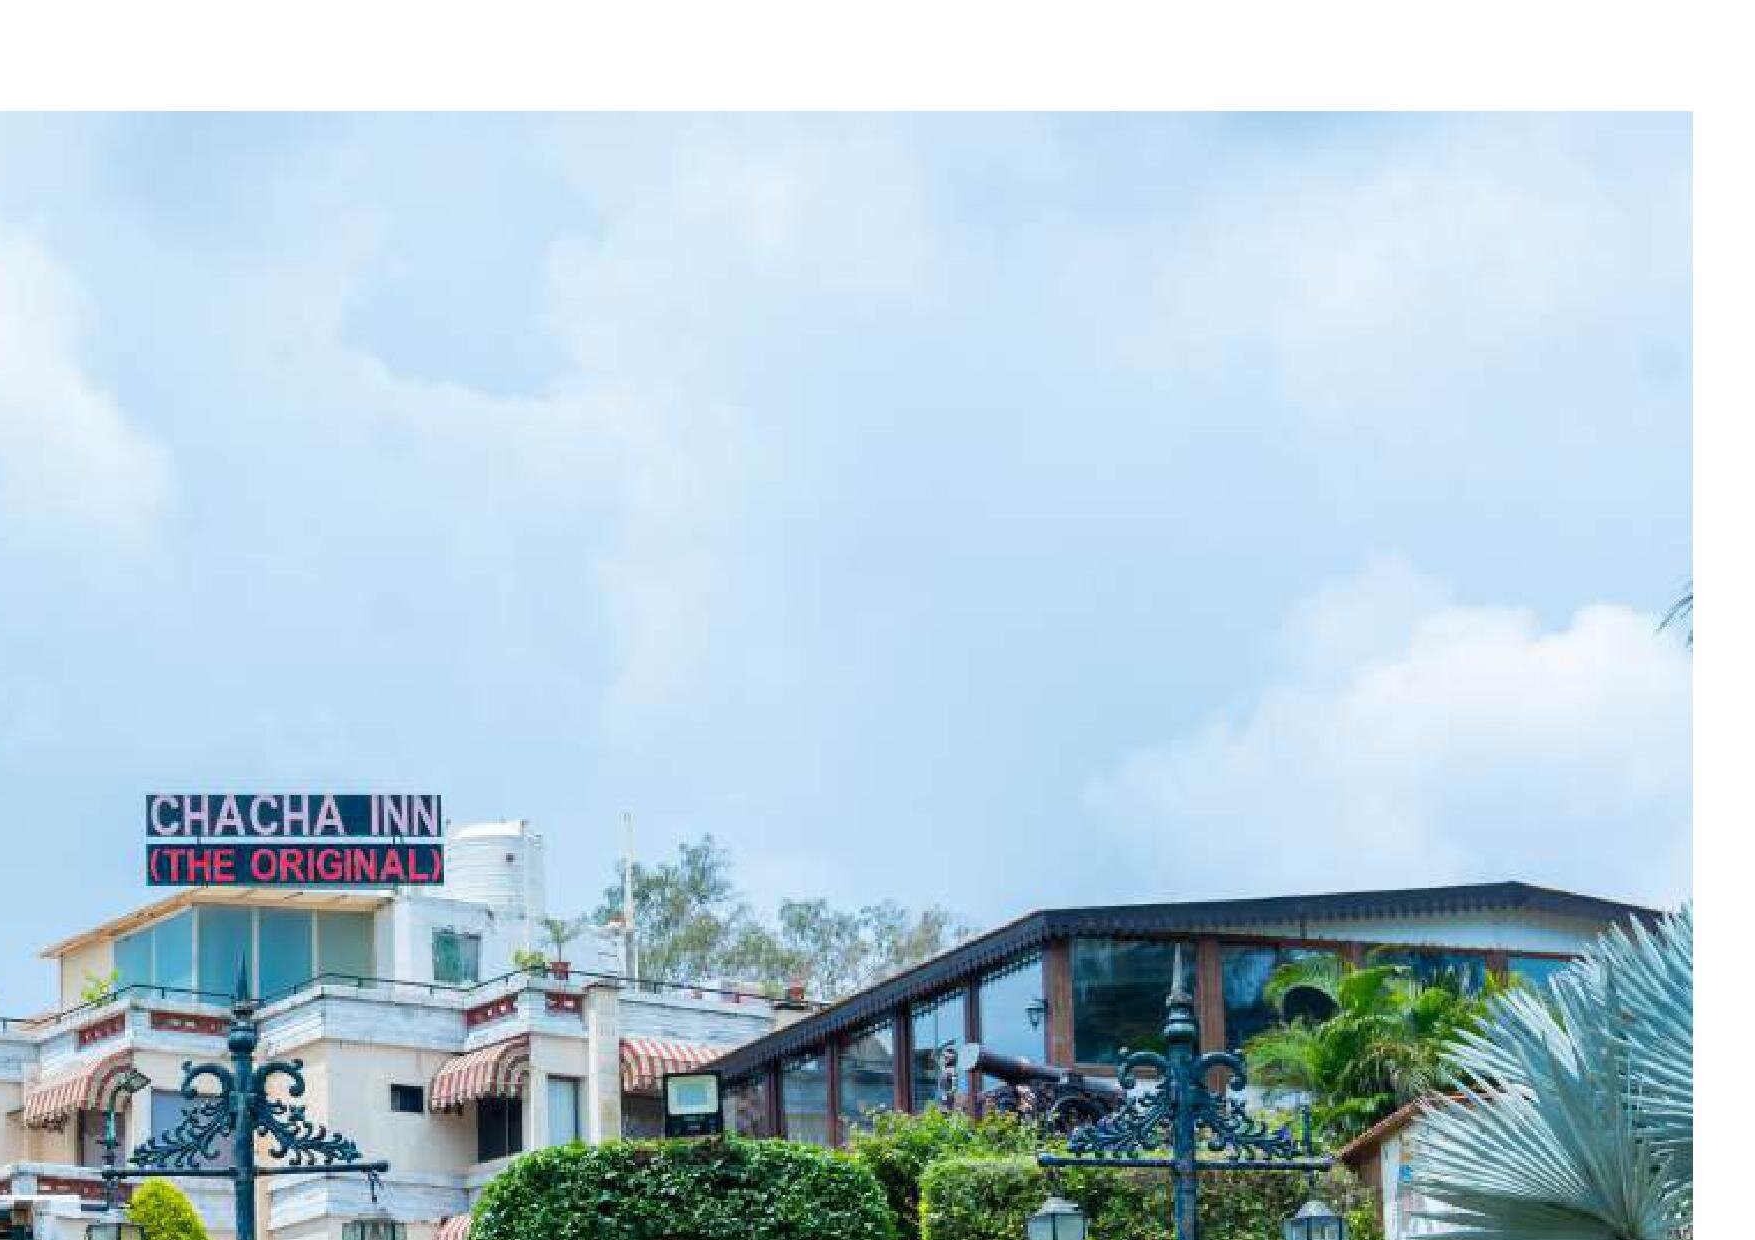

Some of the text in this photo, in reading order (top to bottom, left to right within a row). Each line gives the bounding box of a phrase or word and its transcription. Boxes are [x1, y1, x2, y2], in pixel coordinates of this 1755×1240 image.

[151, 795, 437, 836] CHACHA INN
[150, 848, 442, 882] (THE ORIGINAL)
